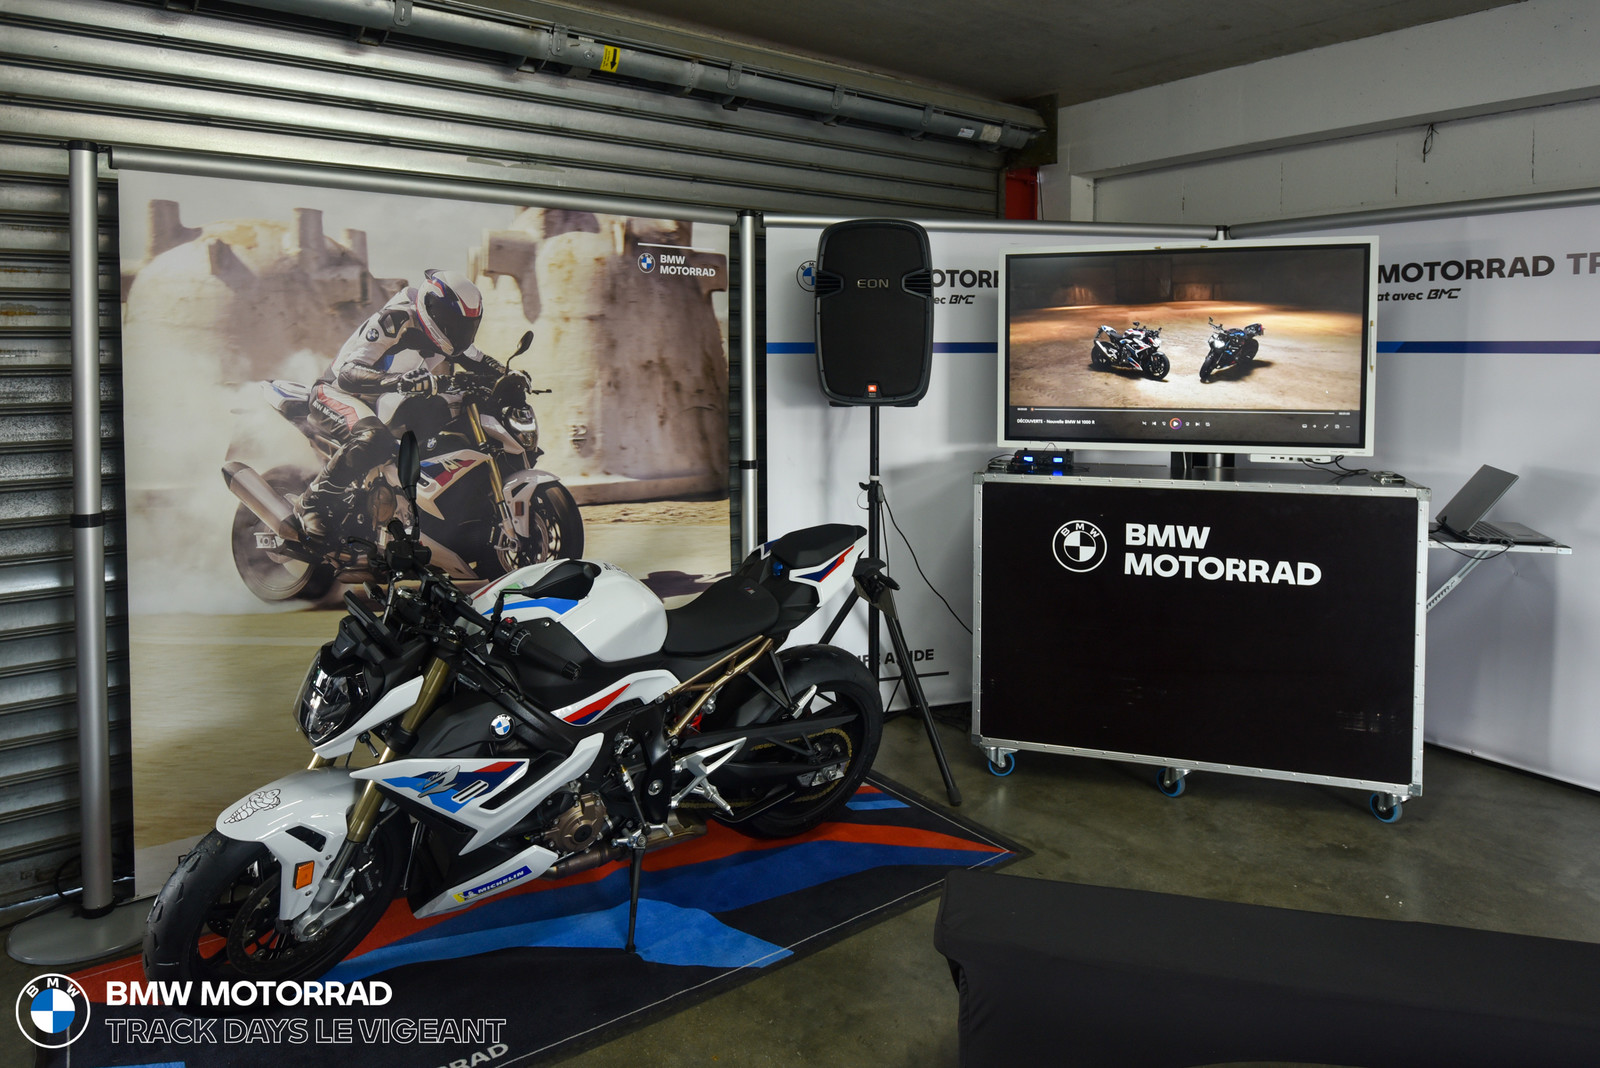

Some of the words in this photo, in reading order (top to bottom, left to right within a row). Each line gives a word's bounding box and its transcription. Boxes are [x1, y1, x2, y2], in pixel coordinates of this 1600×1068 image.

[660, 254, 686, 265] BMW
[660, 265, 716, 277] MOTORRAD
[1378, 255, 1555, 284] MOTORRAD
[857, 278, 889, 289] EON
[932, 269, 999, 288] OTOR
[949, 294, 976, 305] BMC
[1392, 292, 1423, 301] avec
[1427, 288, 1461, 300] BMC
[1061, 522, 1100, 538] BMW
[1125, 522, 1211, 549] BMW
[1124, 552, 1323, 587] MOTORRAD
[477, 870, 525, 894] MICHELIN
[437, 1043, 509, 1068] RAD
